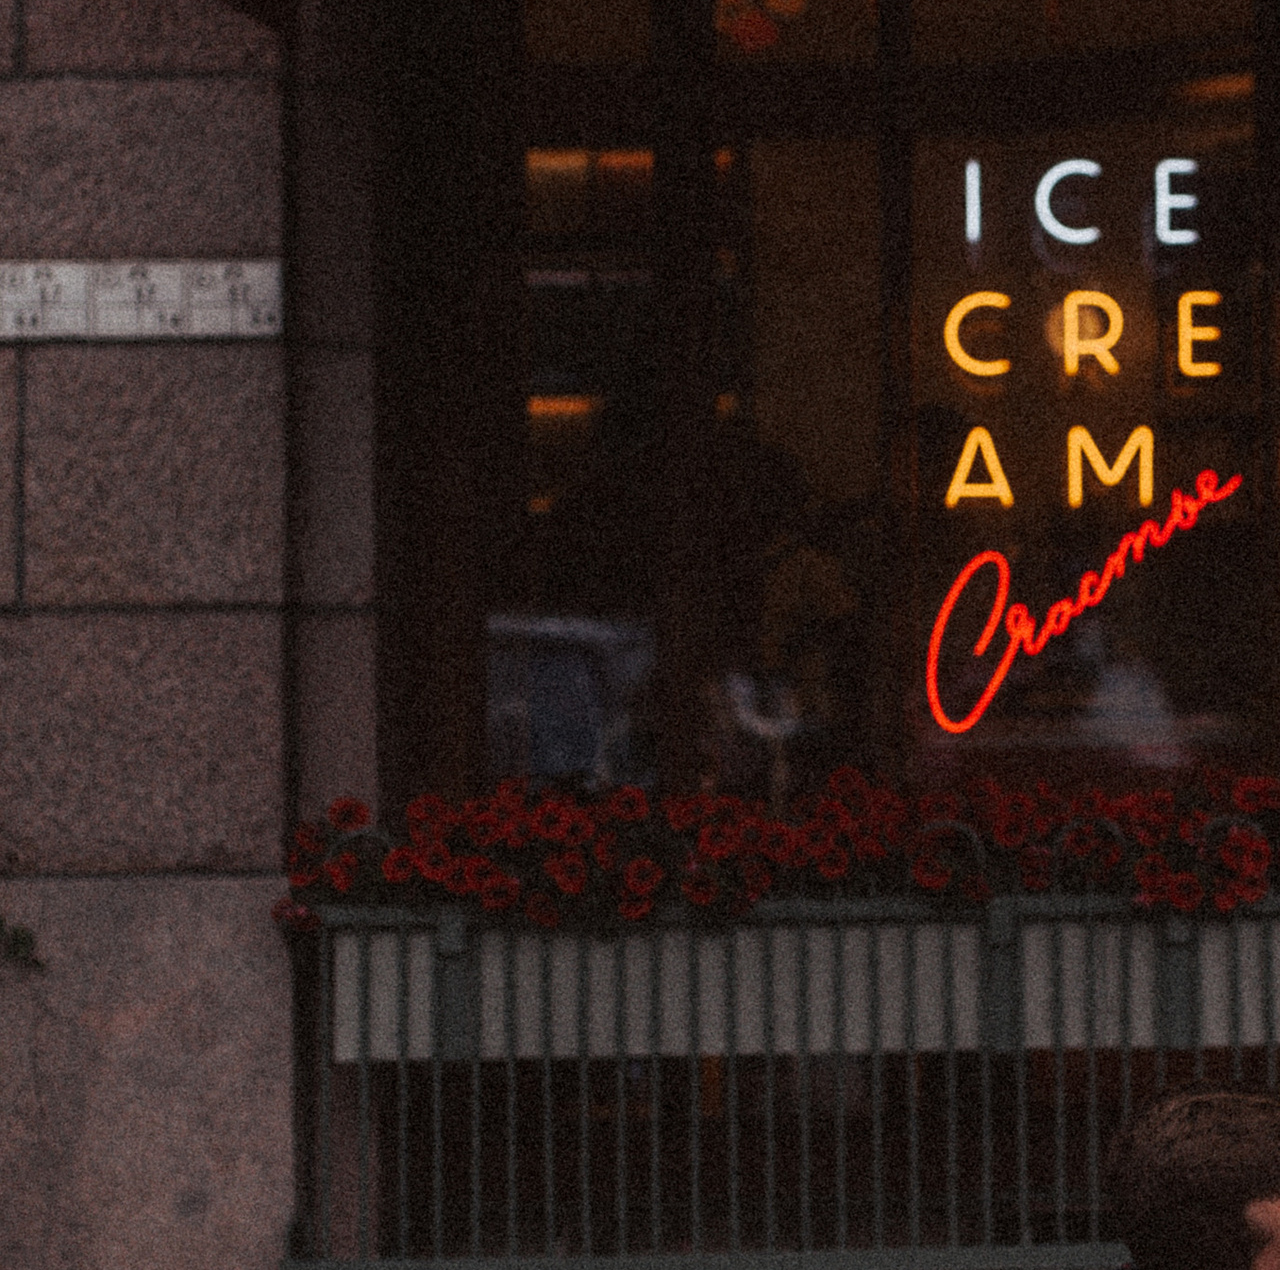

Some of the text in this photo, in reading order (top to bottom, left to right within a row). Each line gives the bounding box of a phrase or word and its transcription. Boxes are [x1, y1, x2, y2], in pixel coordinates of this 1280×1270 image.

[964, 158, 1198, 245] ICE
[943, 289, 1223, 377] CRE
[945, 425, 1155, 509] AM
